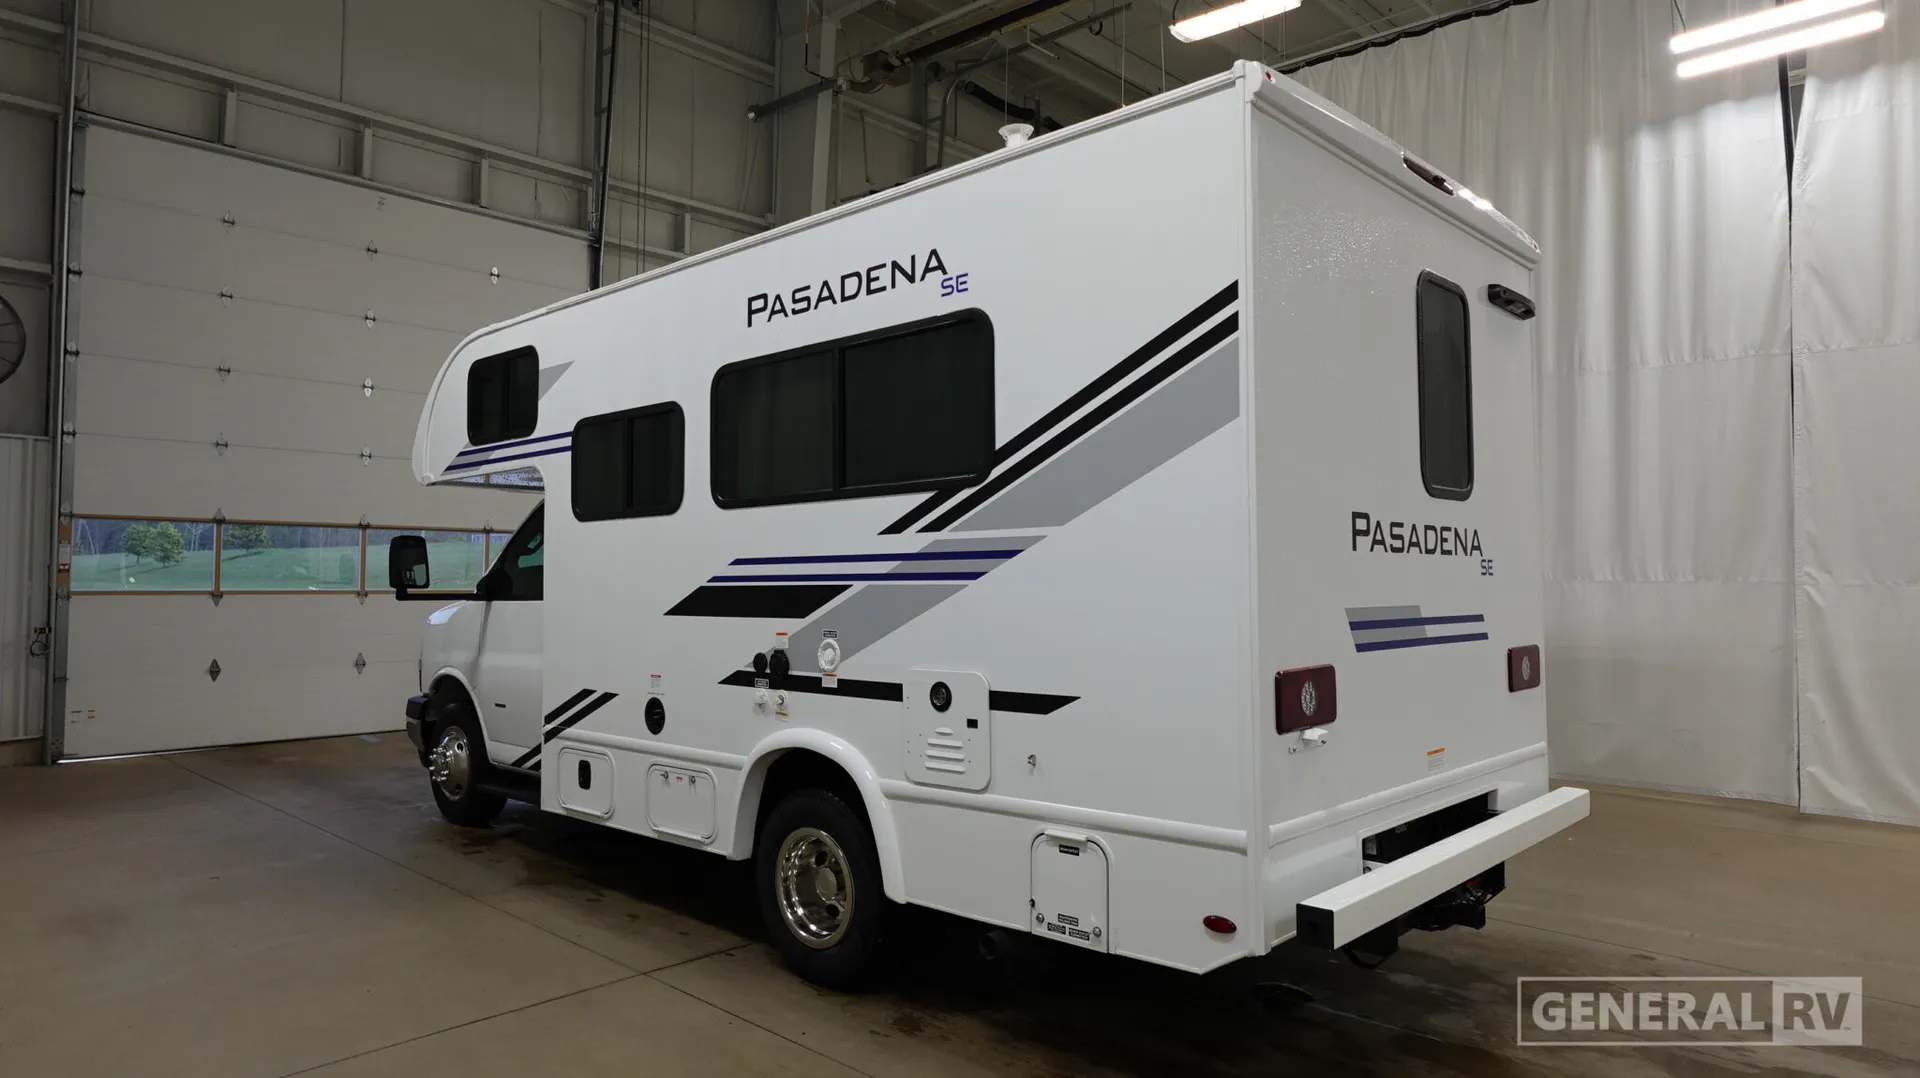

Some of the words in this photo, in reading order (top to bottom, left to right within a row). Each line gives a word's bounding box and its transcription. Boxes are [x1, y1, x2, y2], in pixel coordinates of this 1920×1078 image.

[747, 248, 948, 328] PASADENA
[941, 272, 969, 298] SE
[1351, 511, 1484, 557] PASADENA
[1480, 558, 1494, 576] SE
